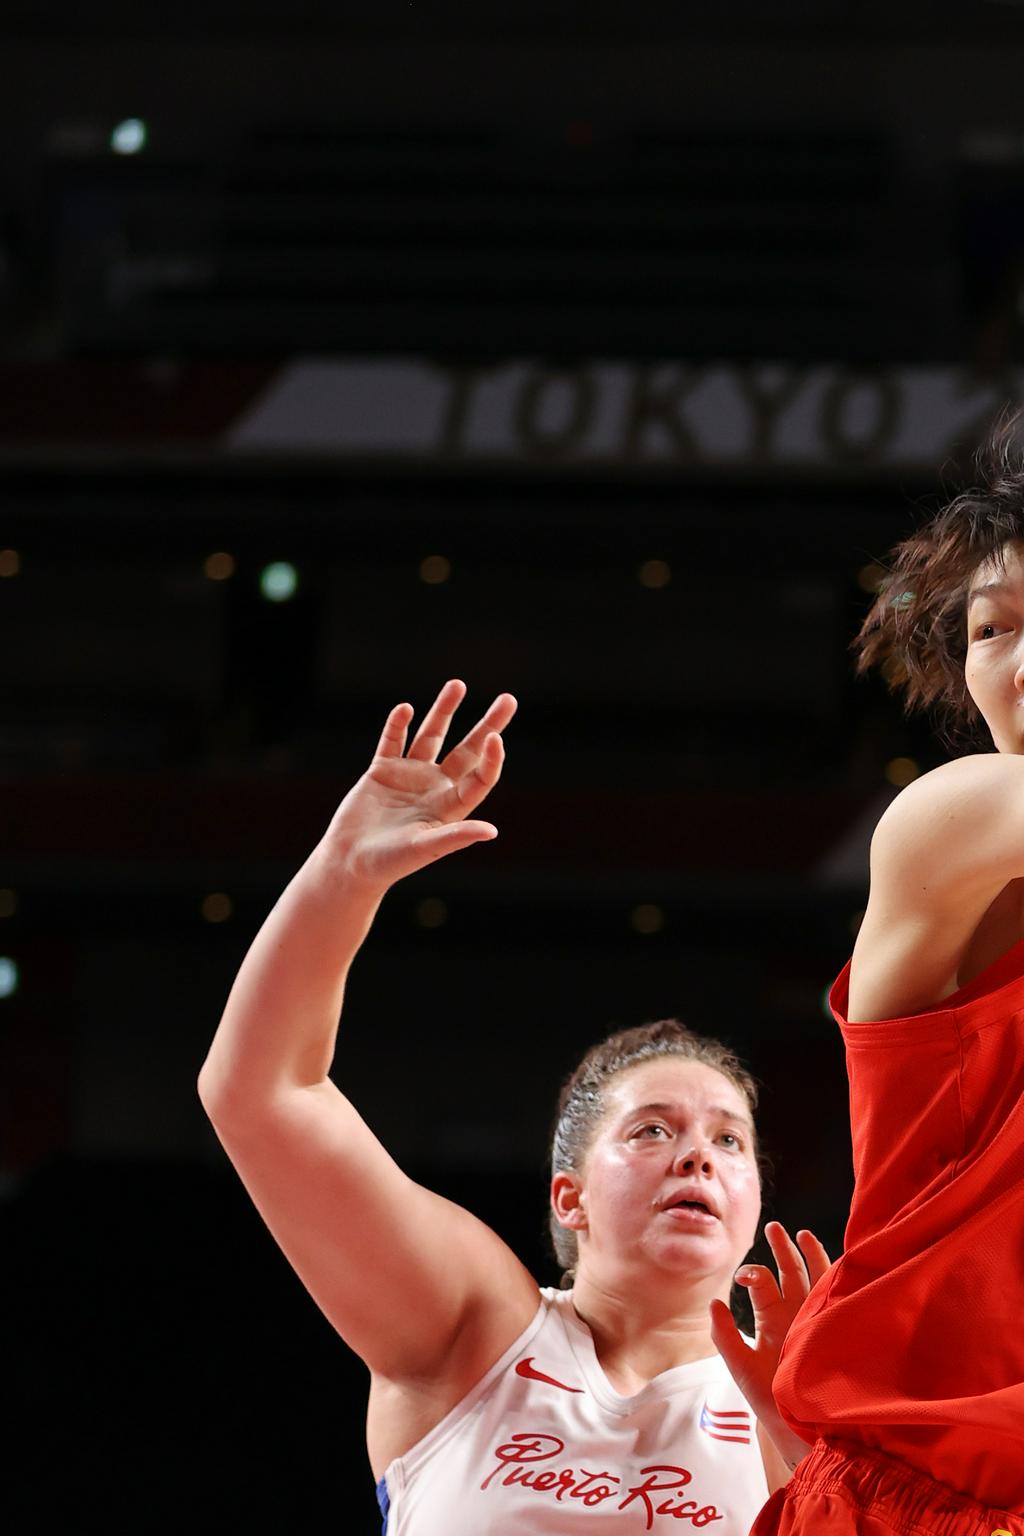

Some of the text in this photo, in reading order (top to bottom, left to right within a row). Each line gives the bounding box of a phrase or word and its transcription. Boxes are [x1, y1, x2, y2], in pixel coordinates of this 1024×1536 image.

[432, 355, 908, 464] TOKYO
[480, 1433, 724, 1531] Puerto Rico
